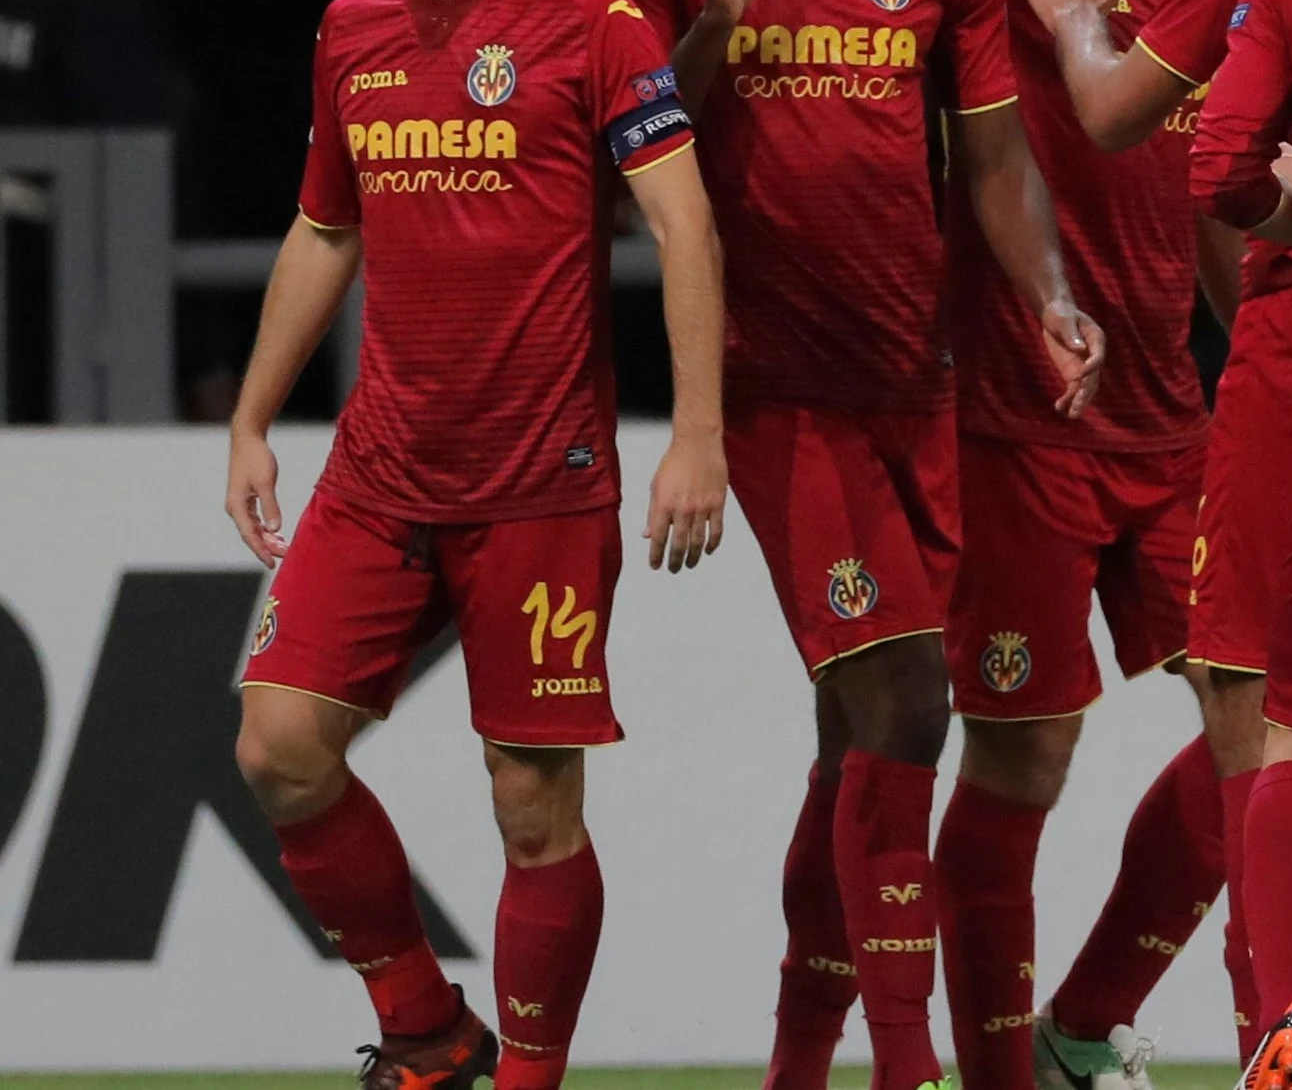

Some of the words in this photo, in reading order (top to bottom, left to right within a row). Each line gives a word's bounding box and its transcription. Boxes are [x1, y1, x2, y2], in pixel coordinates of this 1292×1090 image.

[727, 24, 917, 68] PAMESA
[347, 119, 518, 161] PAMESA
[358, 167, 513, 194] ceramica
[521, 581, 598, 669] 14
[0, 568, 478, 964] K
